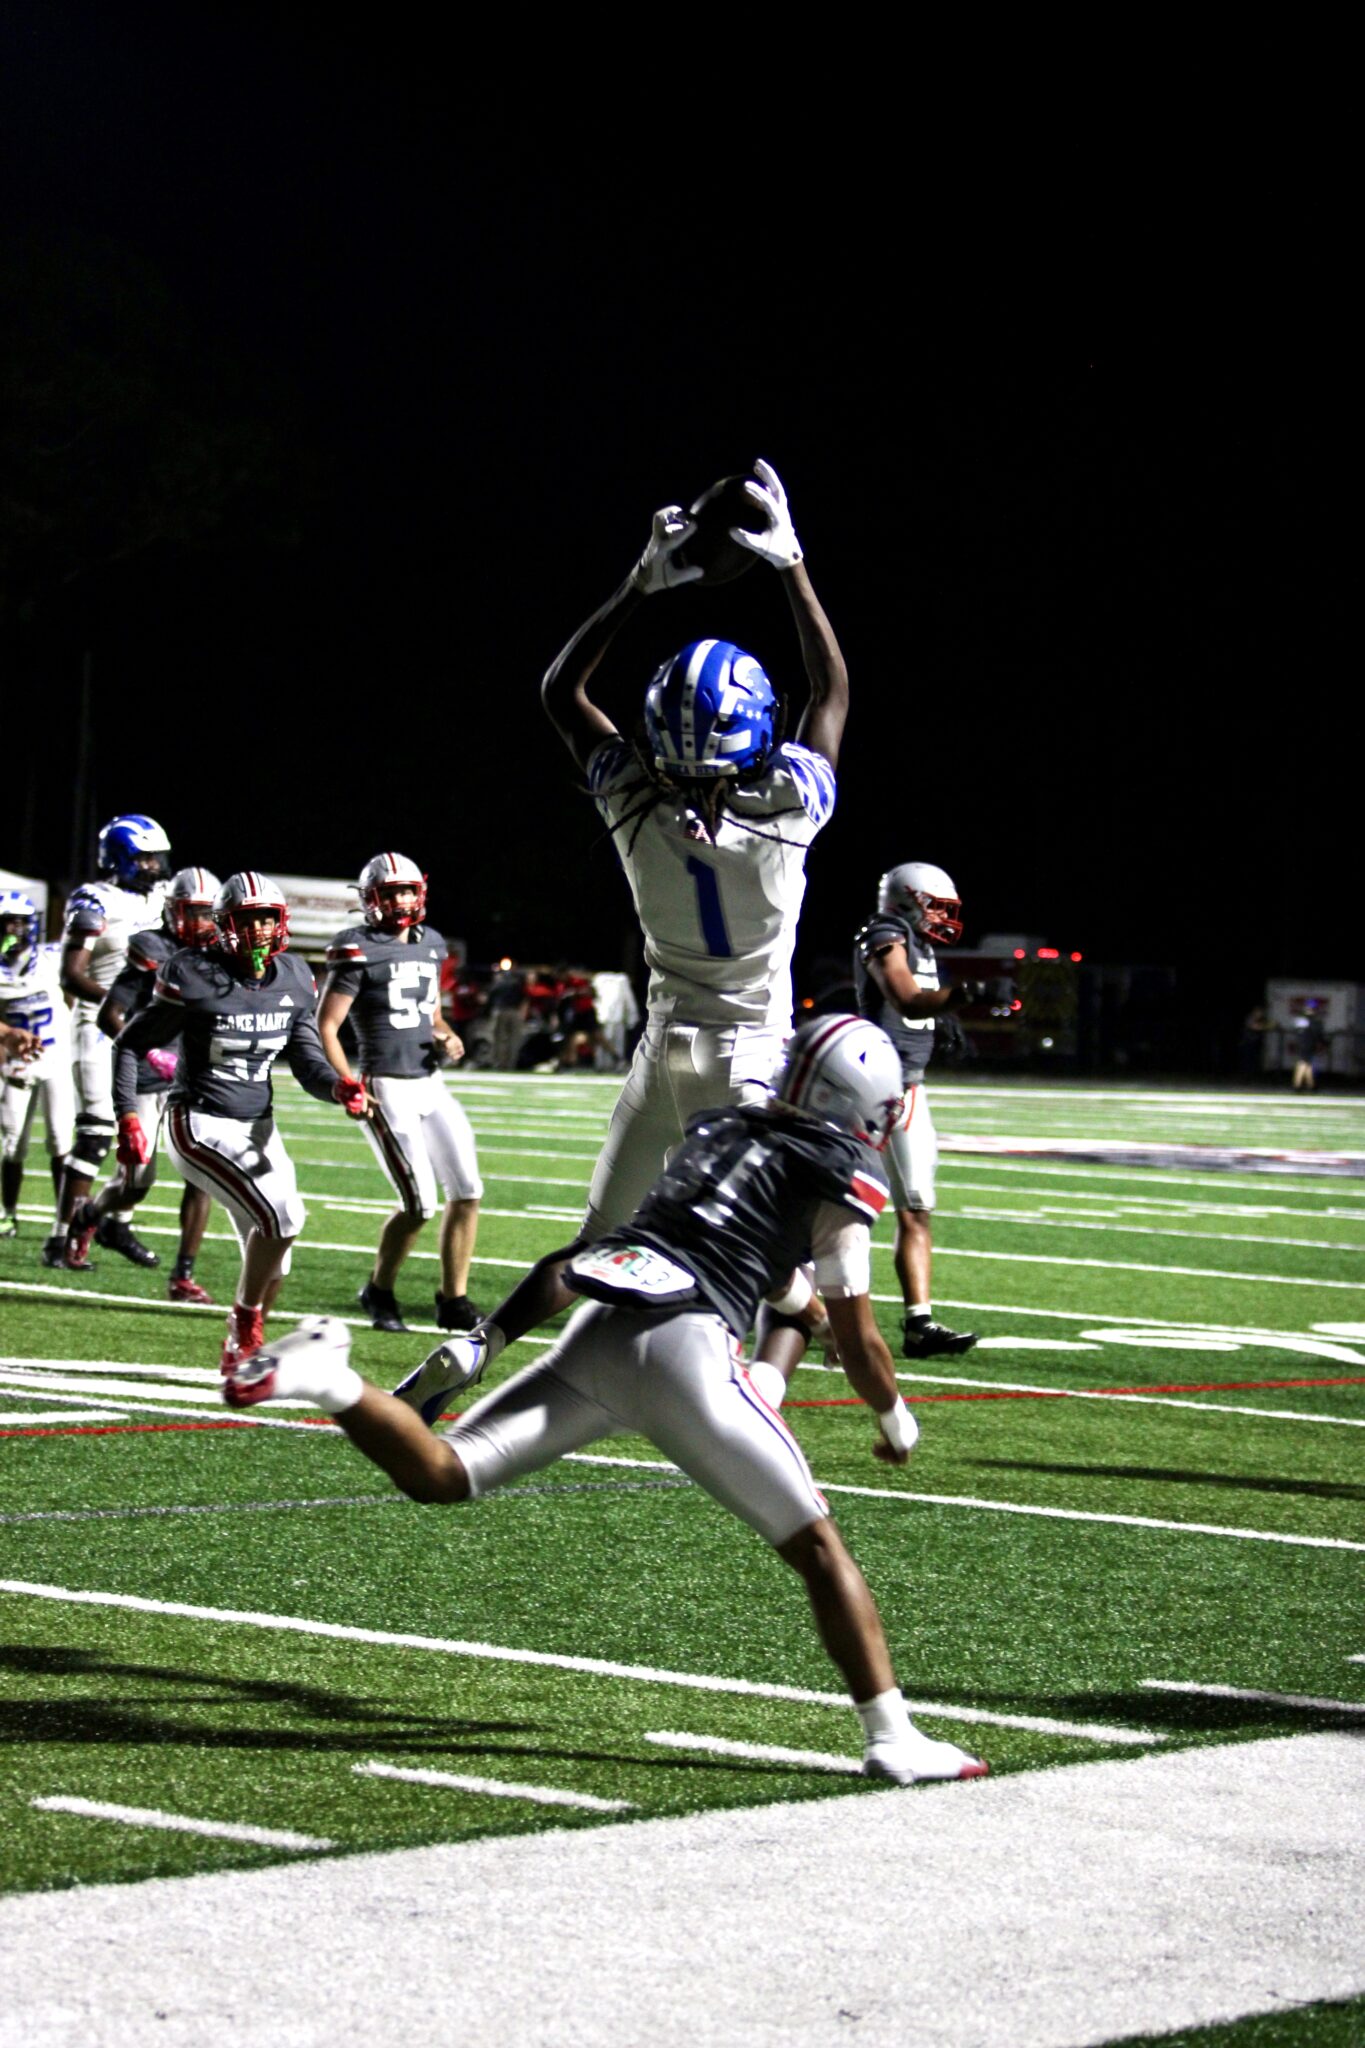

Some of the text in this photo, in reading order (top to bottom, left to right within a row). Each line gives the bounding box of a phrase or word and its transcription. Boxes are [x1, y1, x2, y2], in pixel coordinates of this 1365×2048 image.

[687, 855, 732, 958] 1
[216, 1012, 291, 1032] LAKE MARY
[210, 1035, 287, 1082] 57
